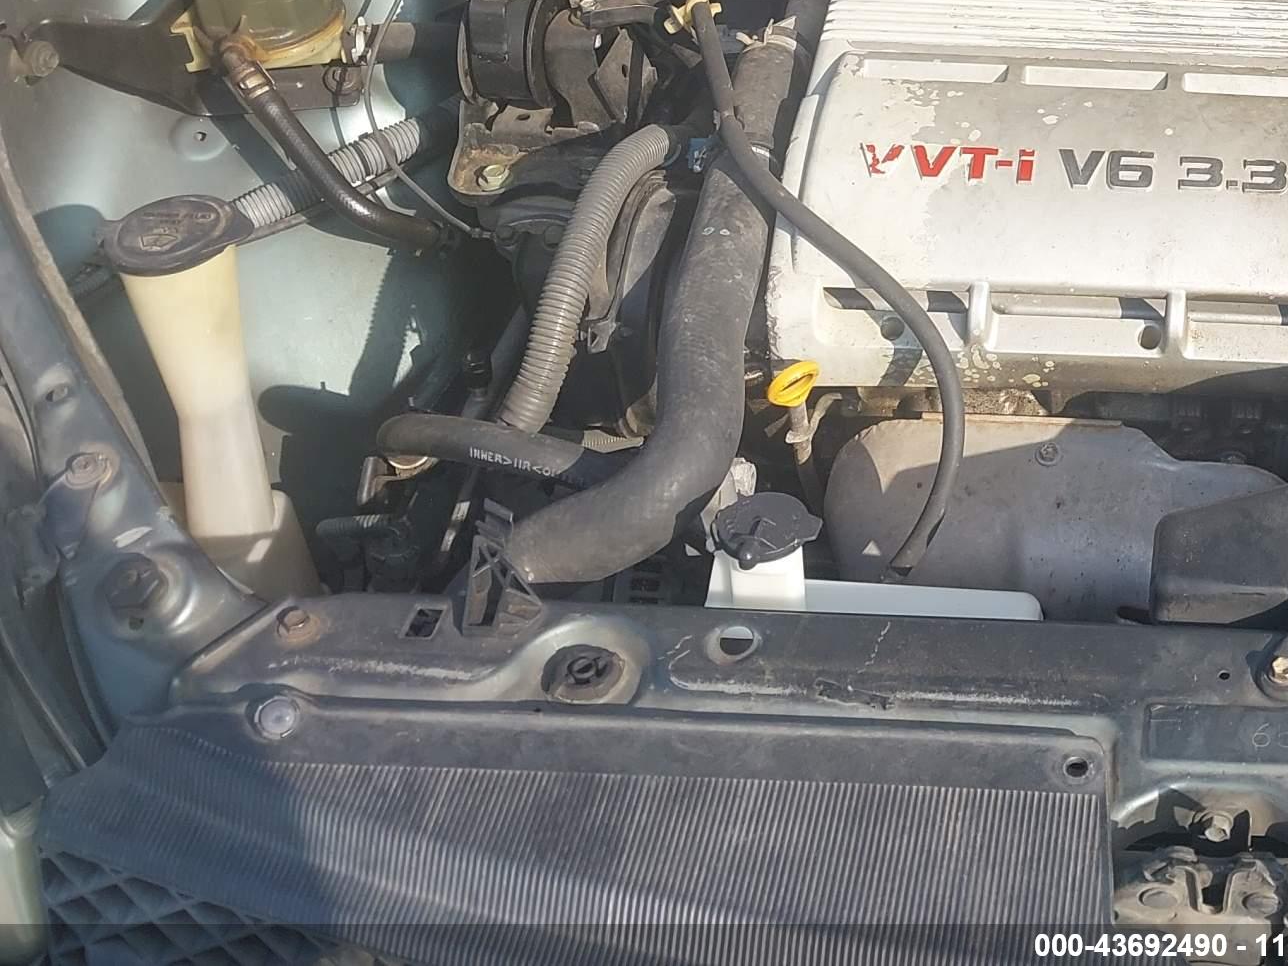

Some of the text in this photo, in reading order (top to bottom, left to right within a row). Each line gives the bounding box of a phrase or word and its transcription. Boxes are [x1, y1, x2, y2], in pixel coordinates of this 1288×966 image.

[858, 141, 1288, 194] VVT-i V6 3.3
